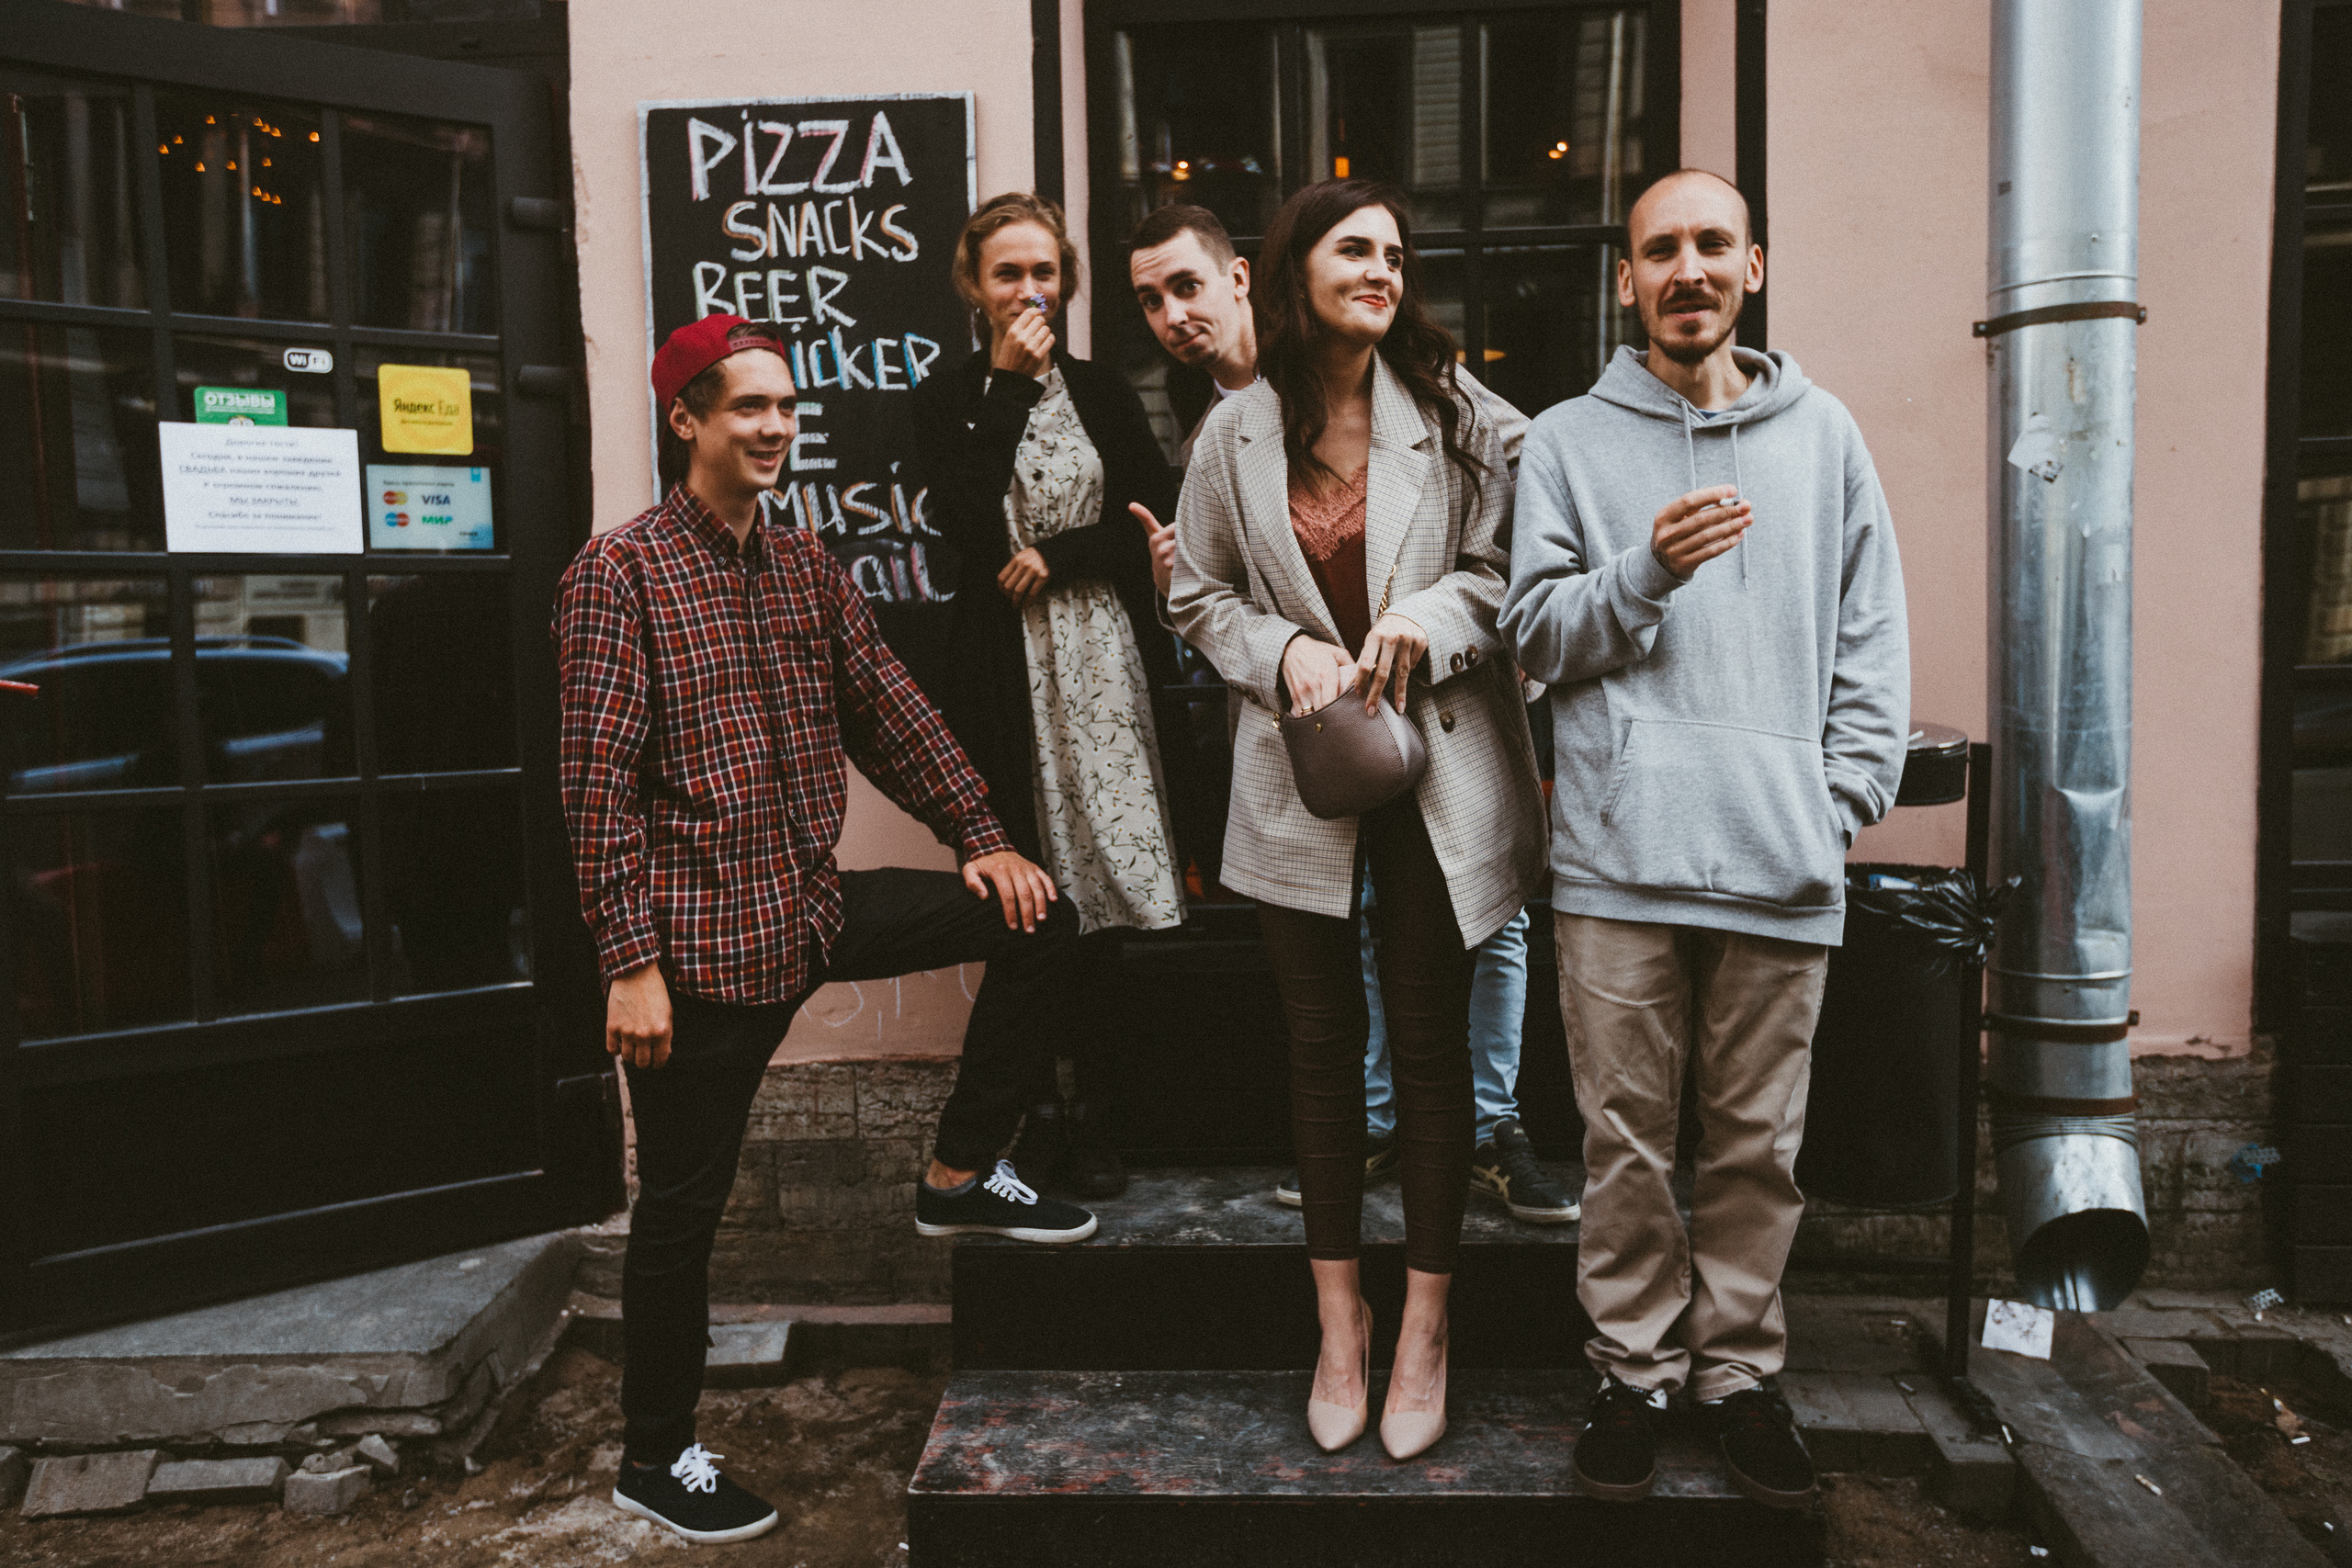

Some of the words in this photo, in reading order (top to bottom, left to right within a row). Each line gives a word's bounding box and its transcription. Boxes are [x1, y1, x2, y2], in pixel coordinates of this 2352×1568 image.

[722, 196, 919, 262] SNACKS
[692, 261, 857, 328] BEER
[203, 391, 276, 408] ОТЗЫВЫ
[393, 398, 436, 414] Яндекс
[422, 495, 451, 505] VISA
[422, 515, 453, 525] МИР
